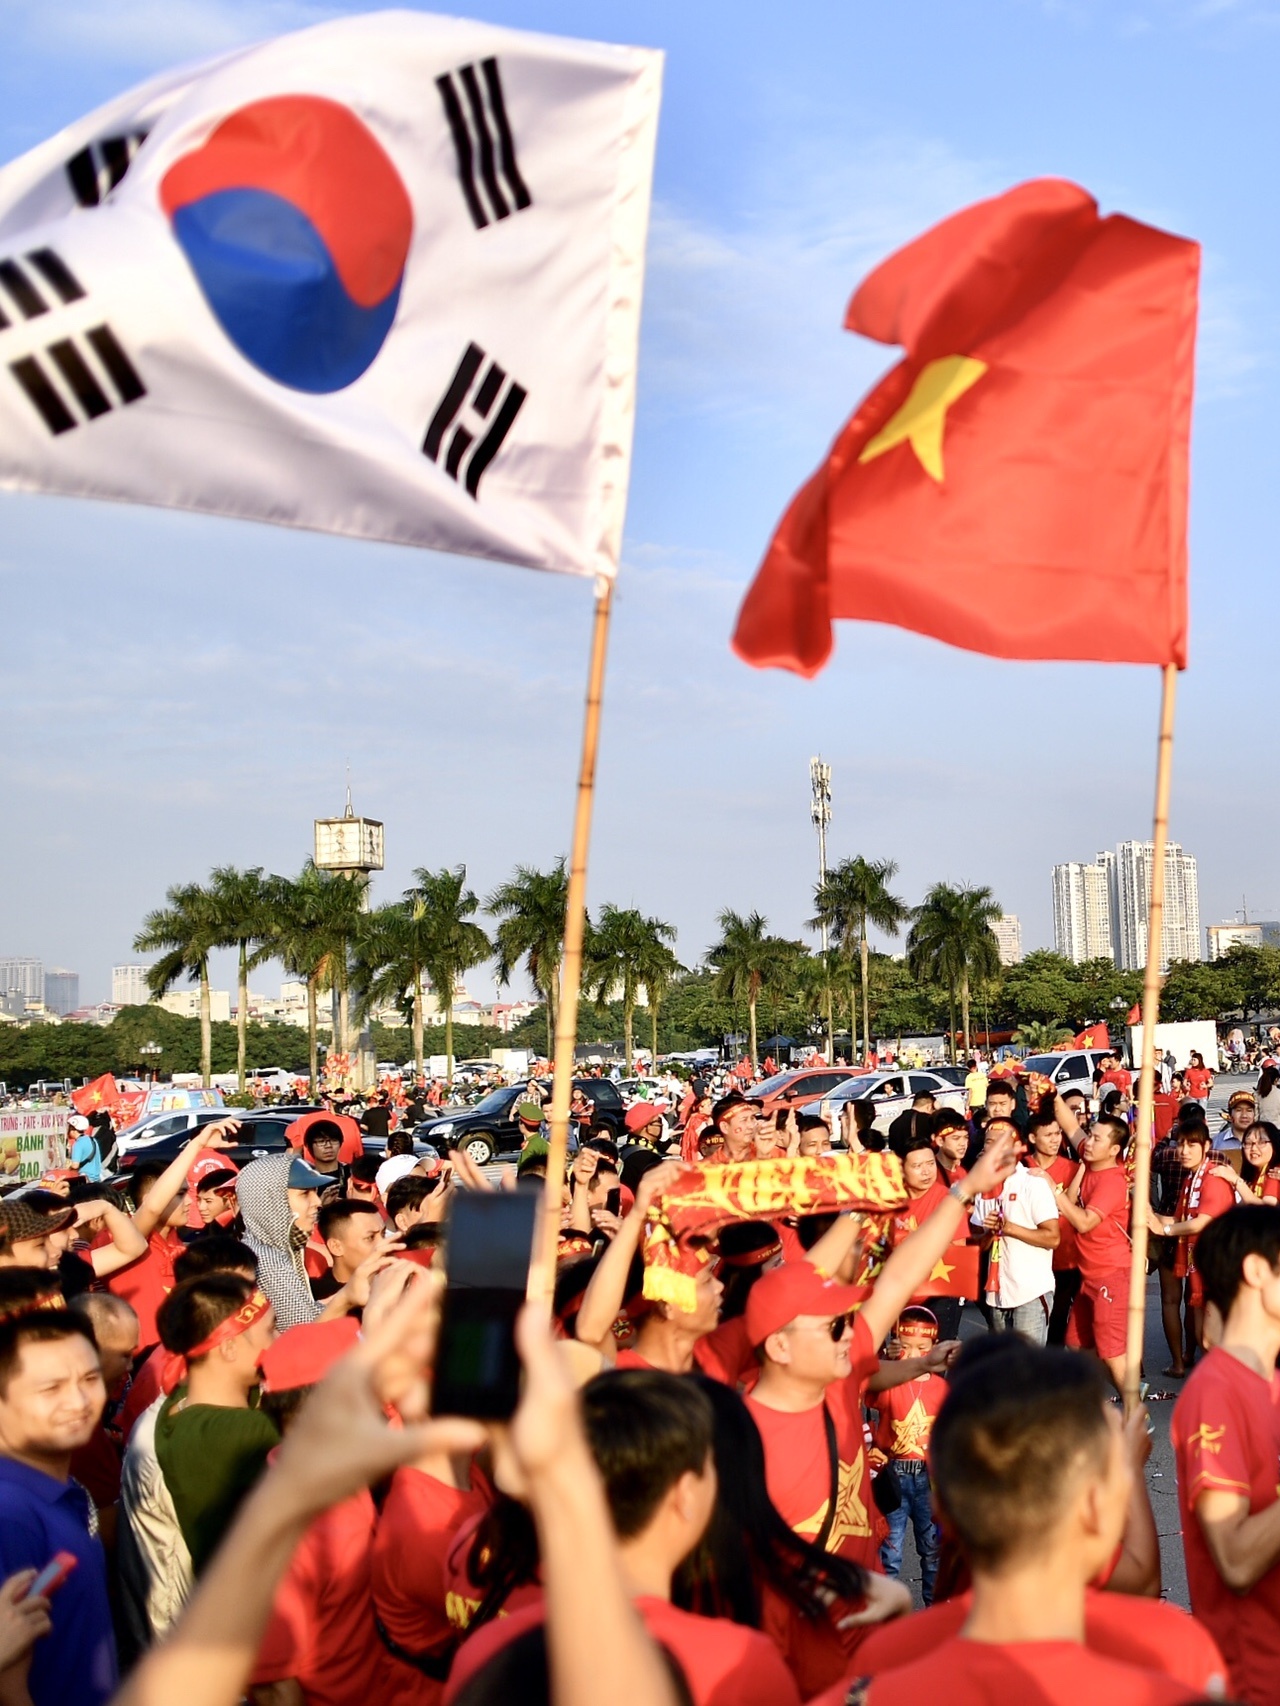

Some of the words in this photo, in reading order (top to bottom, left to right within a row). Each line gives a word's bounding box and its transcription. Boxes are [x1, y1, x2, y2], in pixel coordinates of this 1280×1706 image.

[24, 1115, 36, 1129] PATE
[16, 1132, 44, 1153] BÁNH
[19, 1161, 40, 1179] BAO
